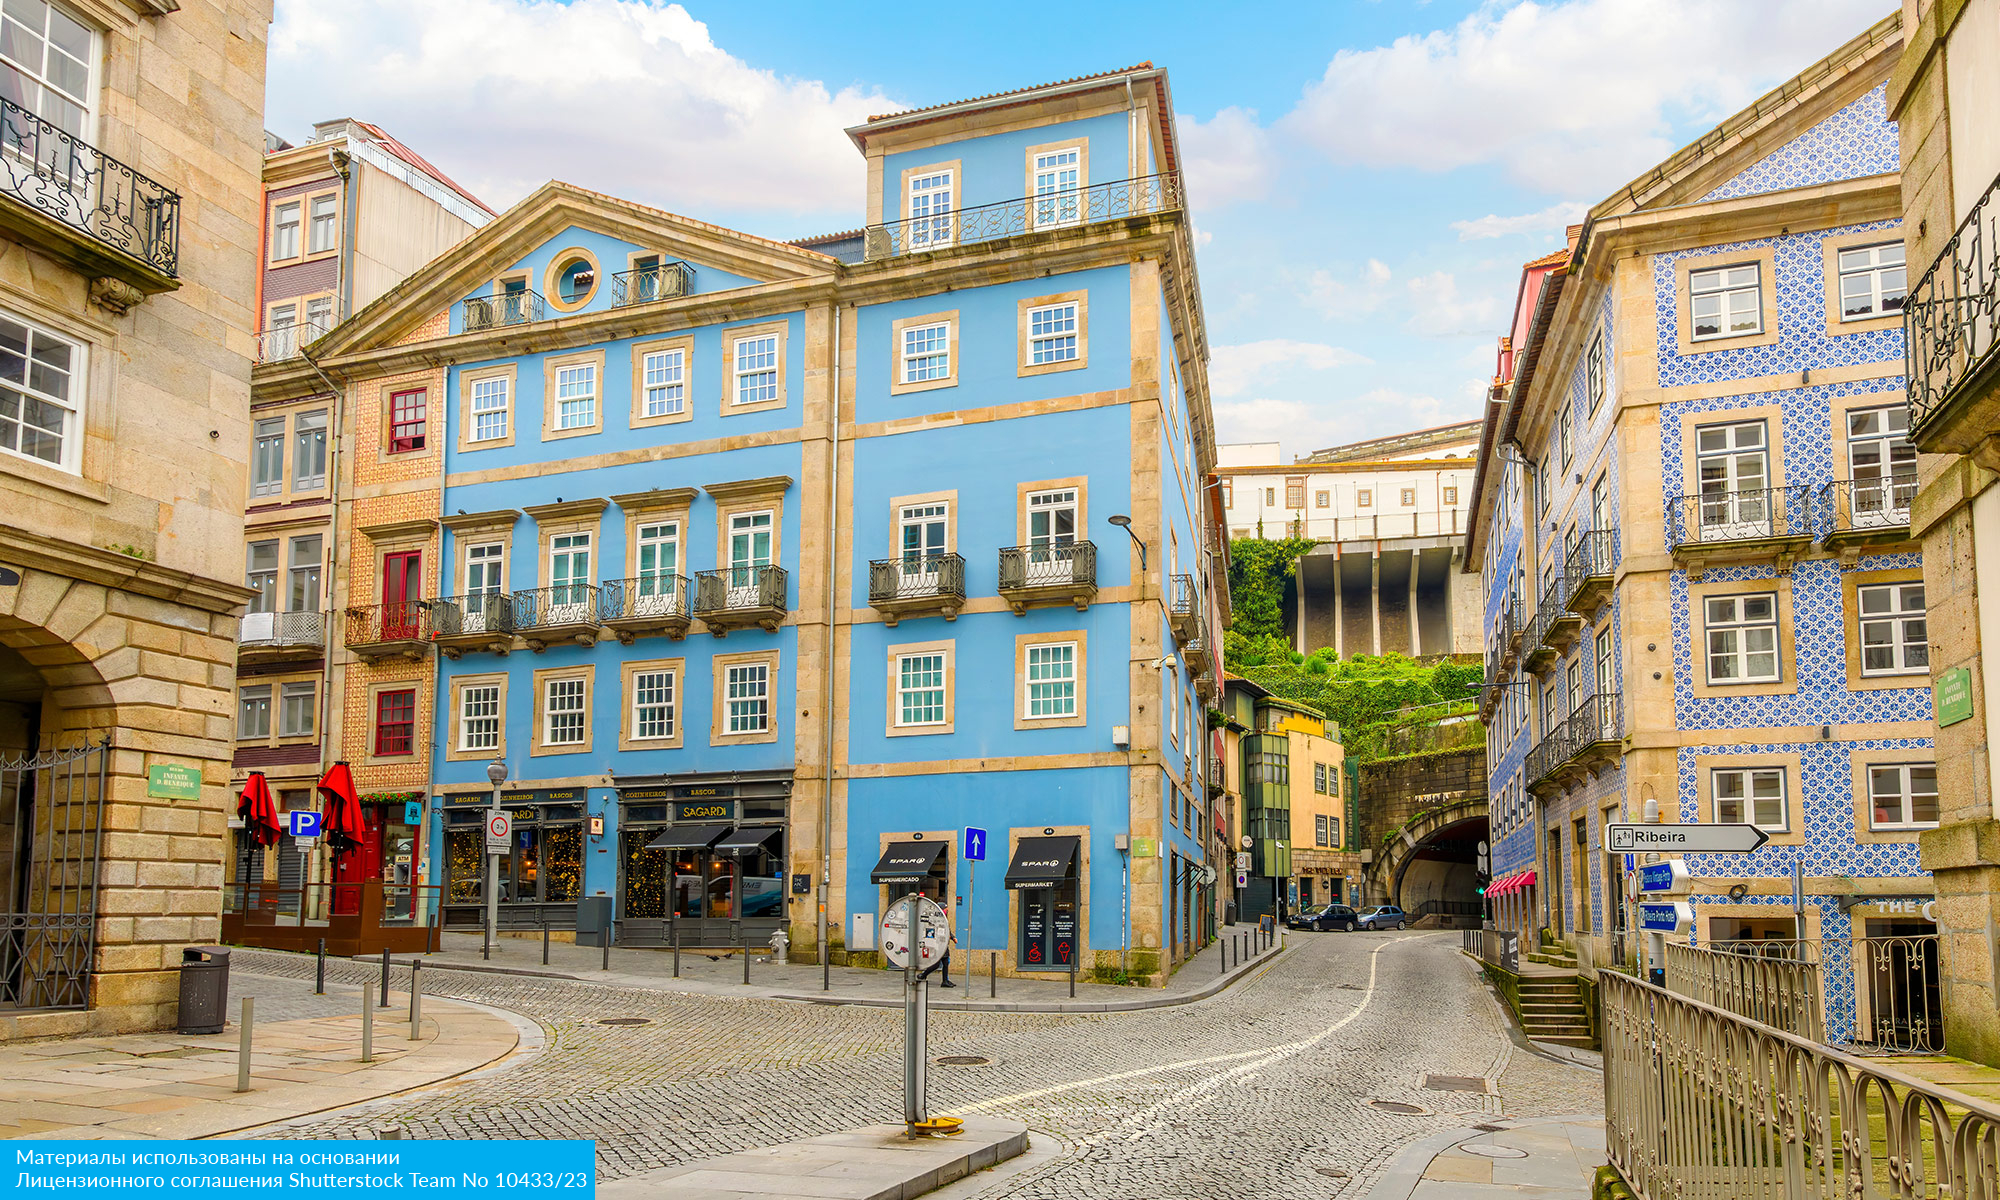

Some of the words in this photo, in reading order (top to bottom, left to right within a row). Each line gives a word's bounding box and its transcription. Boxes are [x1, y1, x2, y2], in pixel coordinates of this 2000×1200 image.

[163, 780, 195, 788] HENRIQUE
[625, 790, 666, 798] COZINHEIROS
[512, 810, 534, 819] ARDI
[683, 806, 727, 817] SAGARDI
[297, 813, 315, 834] P
[1635, 831, 1686, 843] Ribeira
[1876, 901, 1917, 913] THE
